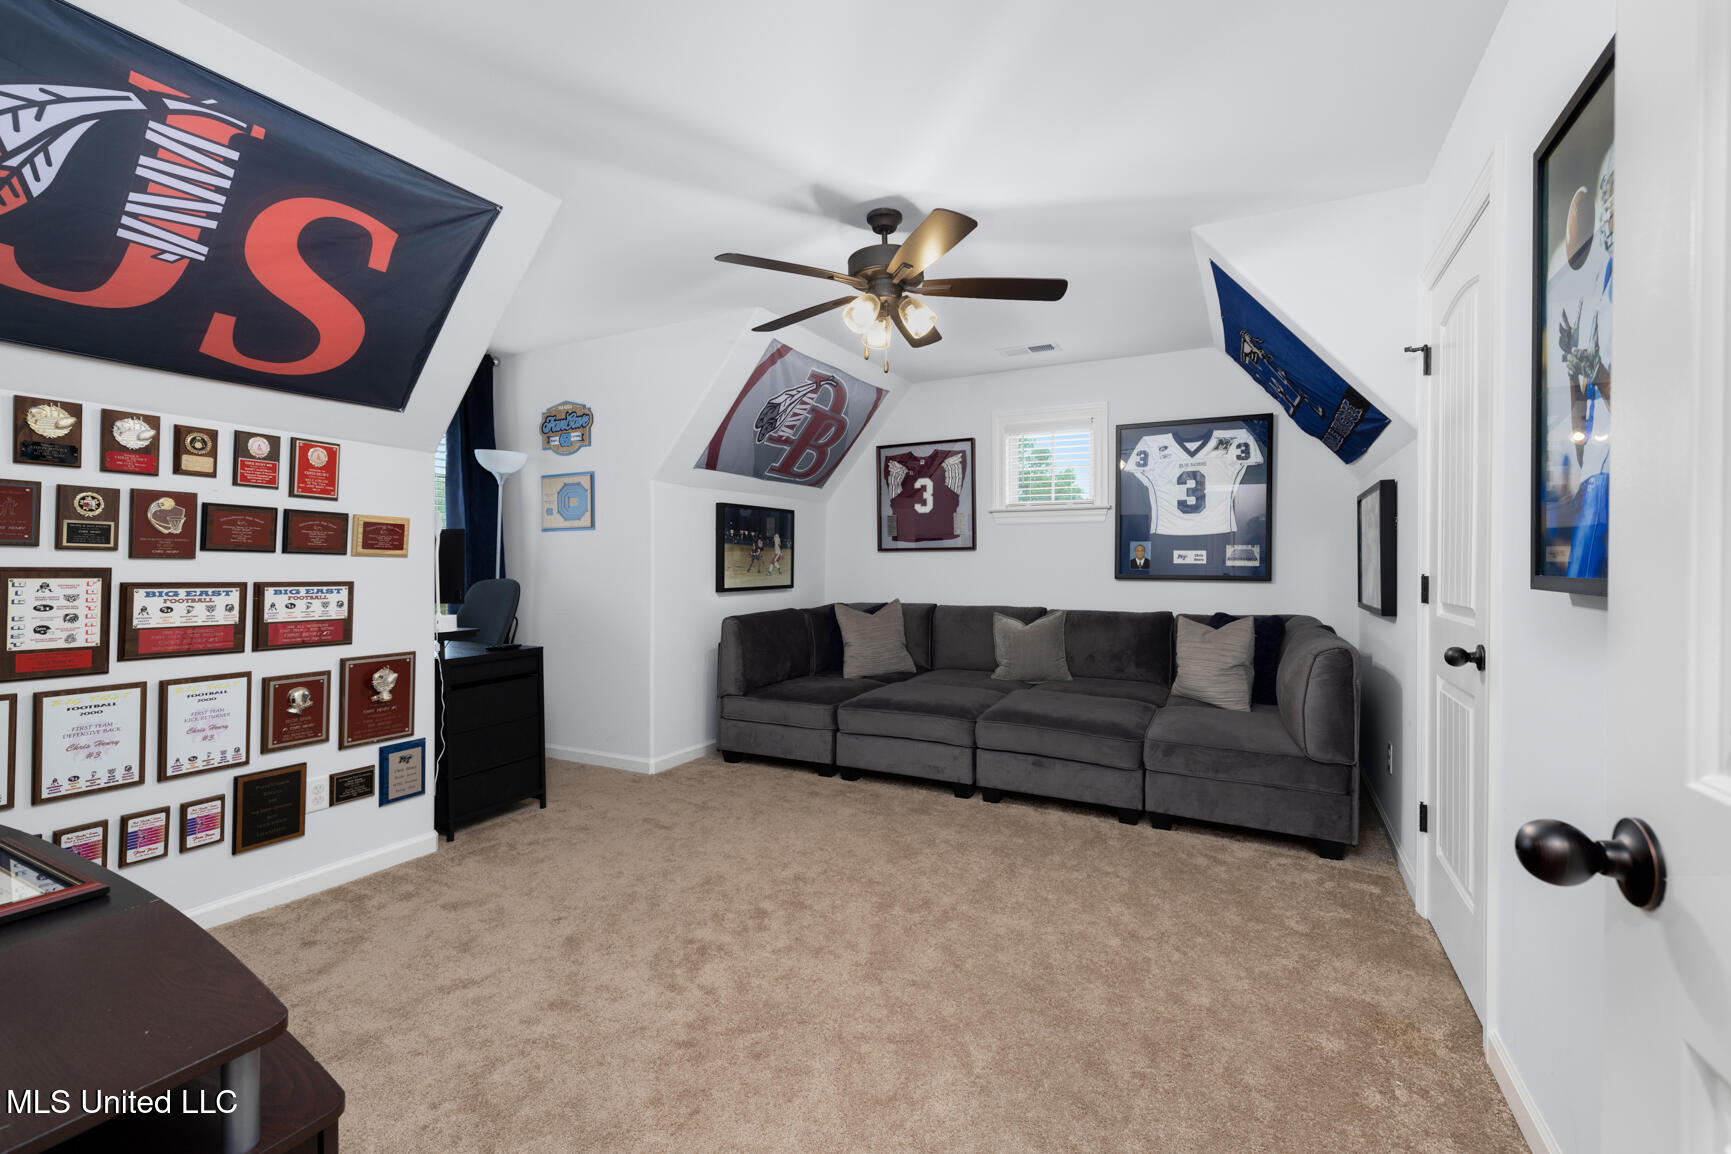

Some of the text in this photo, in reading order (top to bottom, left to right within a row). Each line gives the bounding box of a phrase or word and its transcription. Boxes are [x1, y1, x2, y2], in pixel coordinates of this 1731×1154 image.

[1236, 442, 1250, 461] 3
[1135, 450, 1149, 468] 3
[914, 477, 934, 514] 3
[1177, 471, 1206, 514] 3
[144, 590, 180, 598] BIG
[187, 690, 227, 698] FOOTBALL
[66, 702, 117, 711] FOOTBALL
[71, 724, 92, 732] FIRST
[186, 727, 206, 735] Chris
[62, 730, 100, 740] DEFENSIVE
[65, 739, 121, 752] Chris Henry
[85, 751, 102, 759] #3
